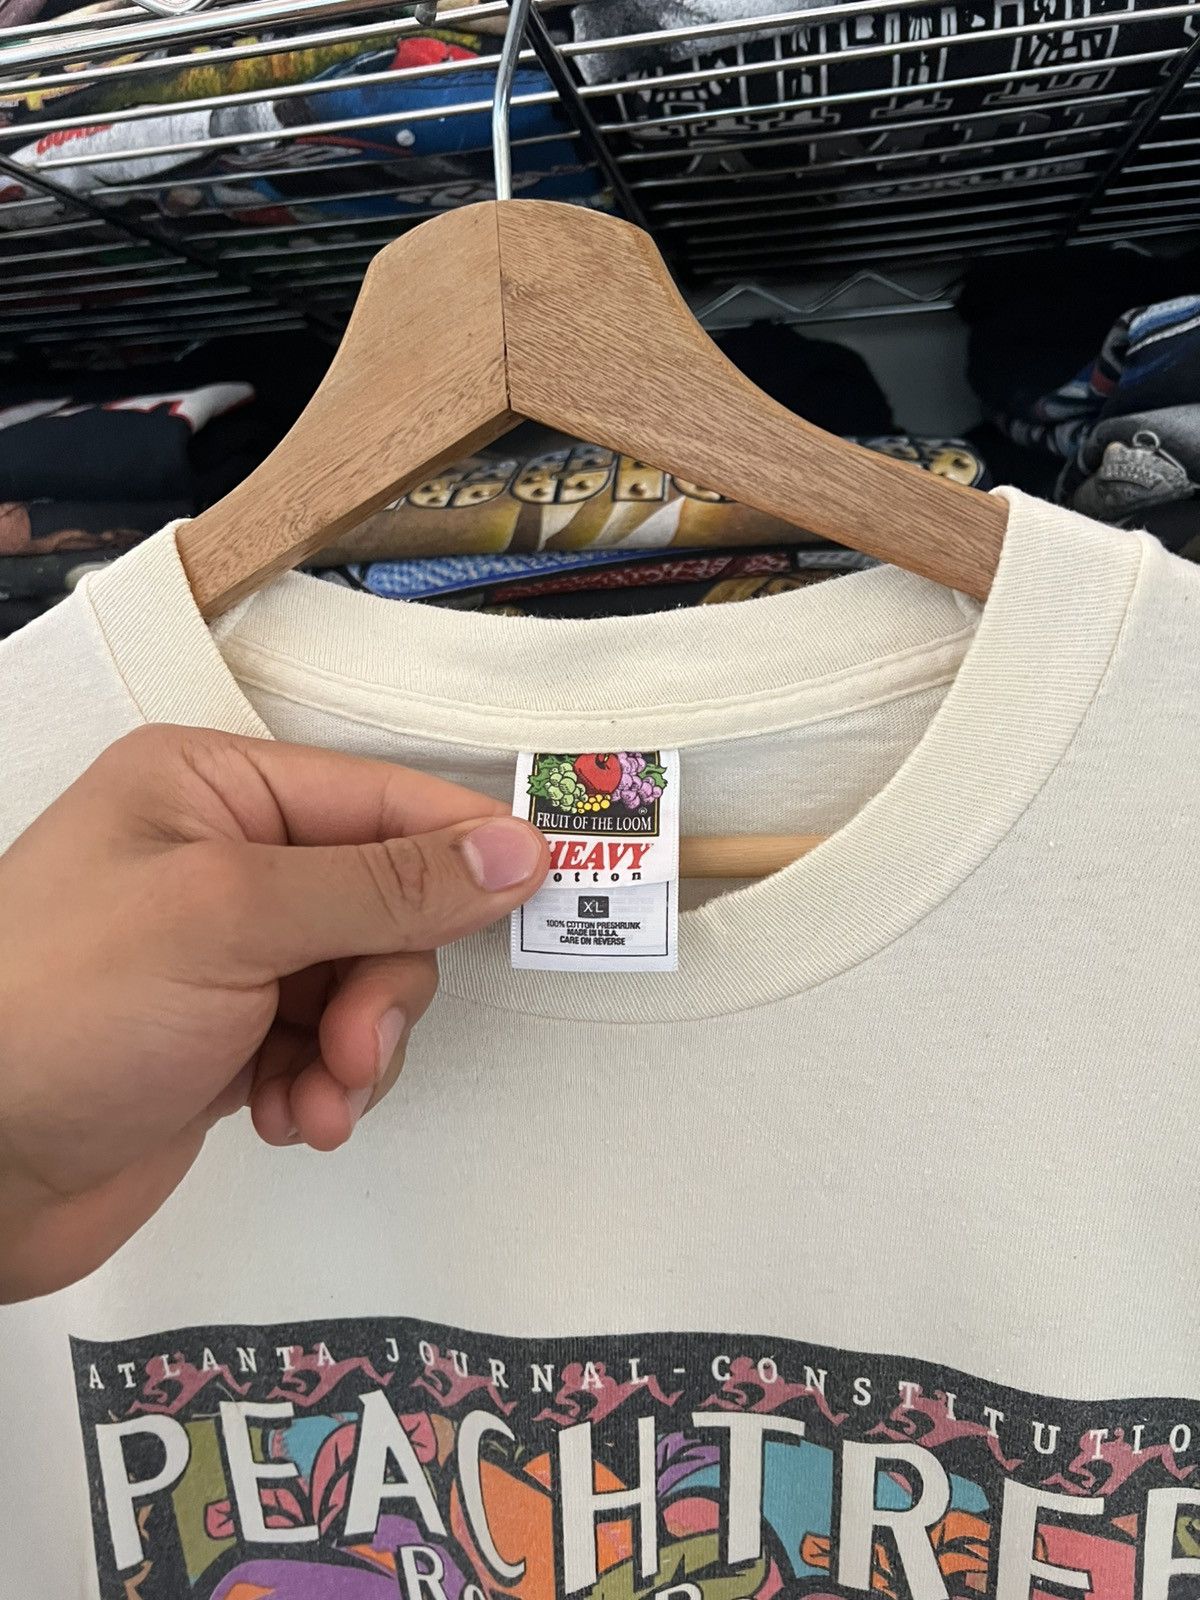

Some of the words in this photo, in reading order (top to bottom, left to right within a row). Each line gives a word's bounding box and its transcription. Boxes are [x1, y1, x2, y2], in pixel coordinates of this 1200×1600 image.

[536, 812, 571, 828] FRUIT
[573, 815, 588, 829] OF
[591, 817, 613, 830] THE
[616, 816, 652, 831] LOOM
[553, 872, 641, 882] otton
[583, 901, 603, 913] XL
[546, 919, 565, 928] 100%
[566, 921, 595, 929] COTTON
[597, 922, 641, 930] PRESHRUNK
[560, 936, 579, 944] CARE
[581, 937, 591, 945] ON
[593, 937, 625, 945] REVERSE
[89, 1340, 336, 1389] ATLANTA
